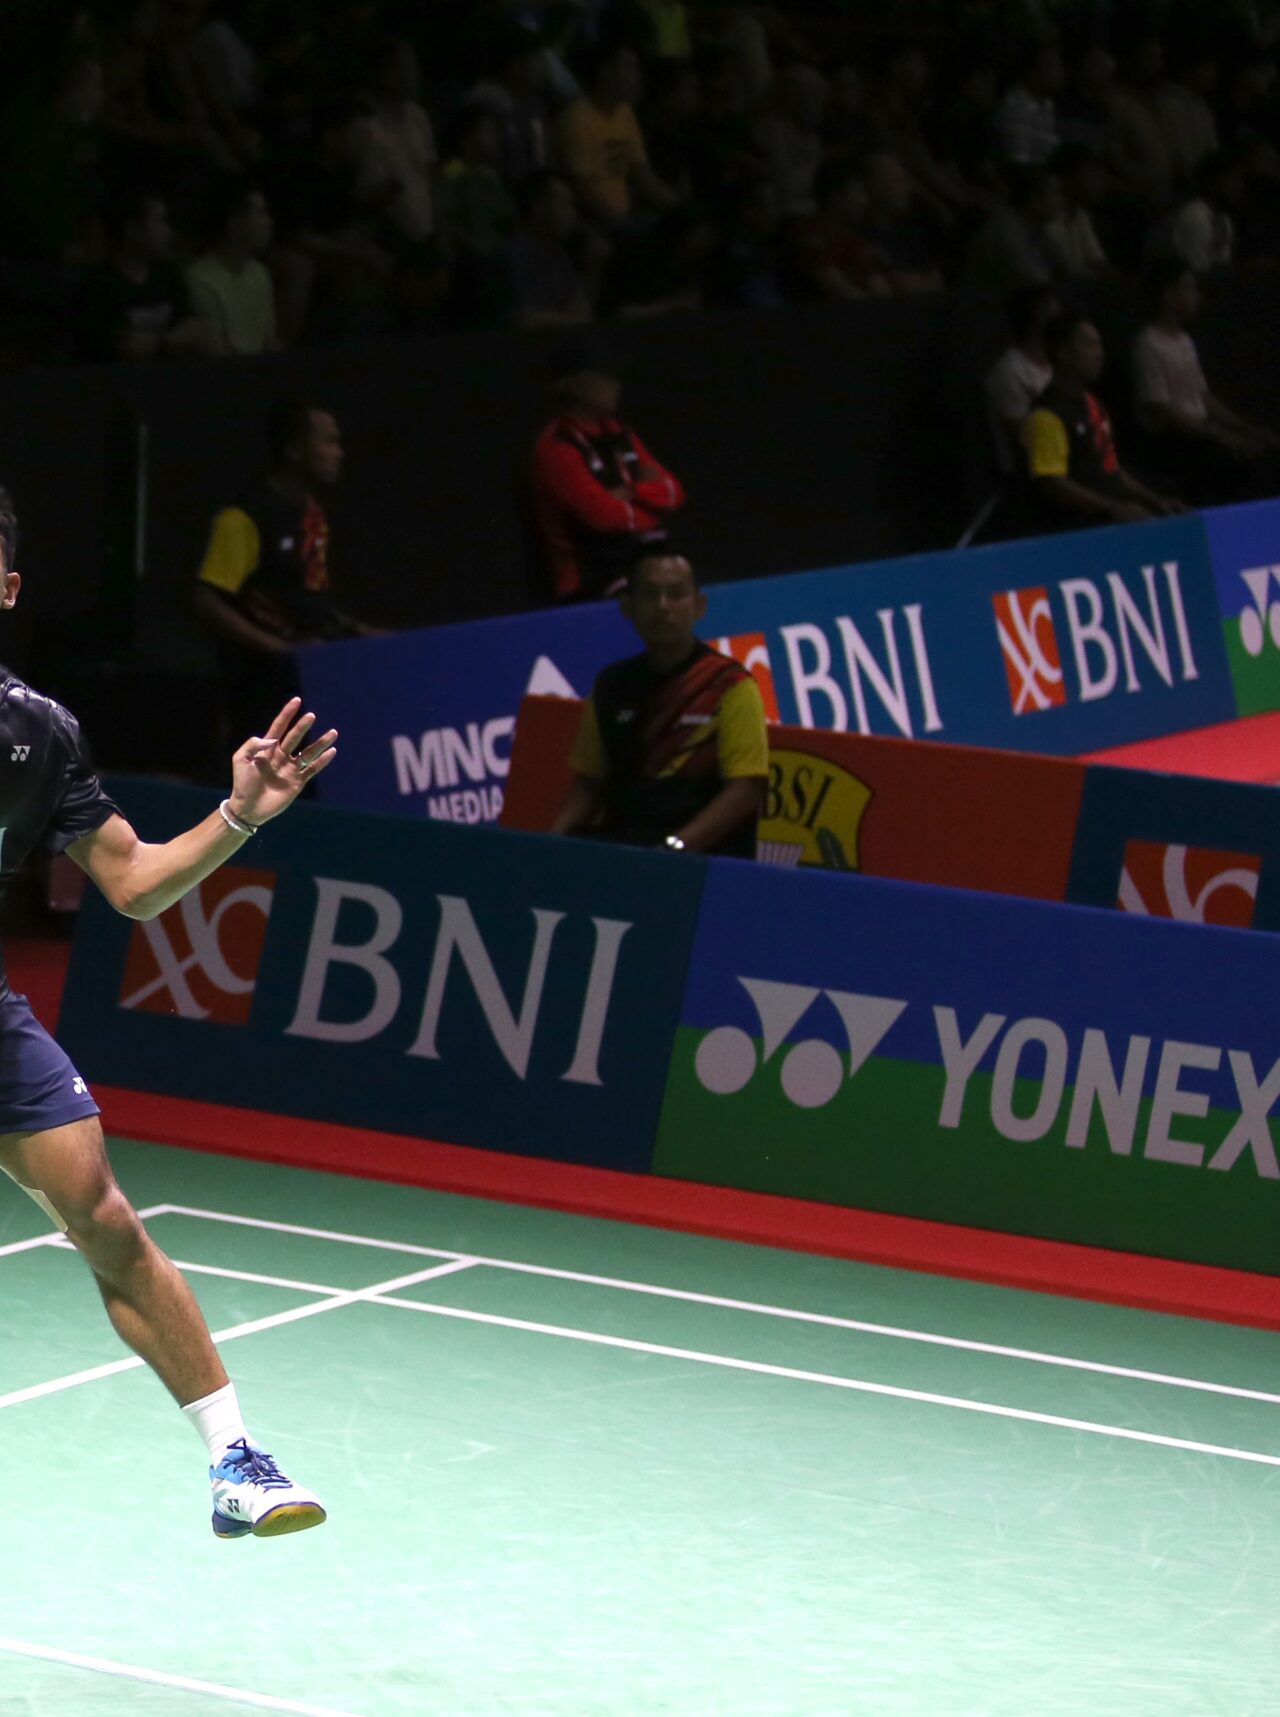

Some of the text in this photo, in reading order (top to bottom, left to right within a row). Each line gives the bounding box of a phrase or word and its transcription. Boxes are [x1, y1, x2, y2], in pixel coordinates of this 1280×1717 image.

[779, 602, 944, 740] BNI
[1058, 561, 1200, 703] BNI
[390, 714, 517, 796] MNC
[284, 876, 634, 1086] BNI
[932, 1004, 1280, 1180] YONEX
